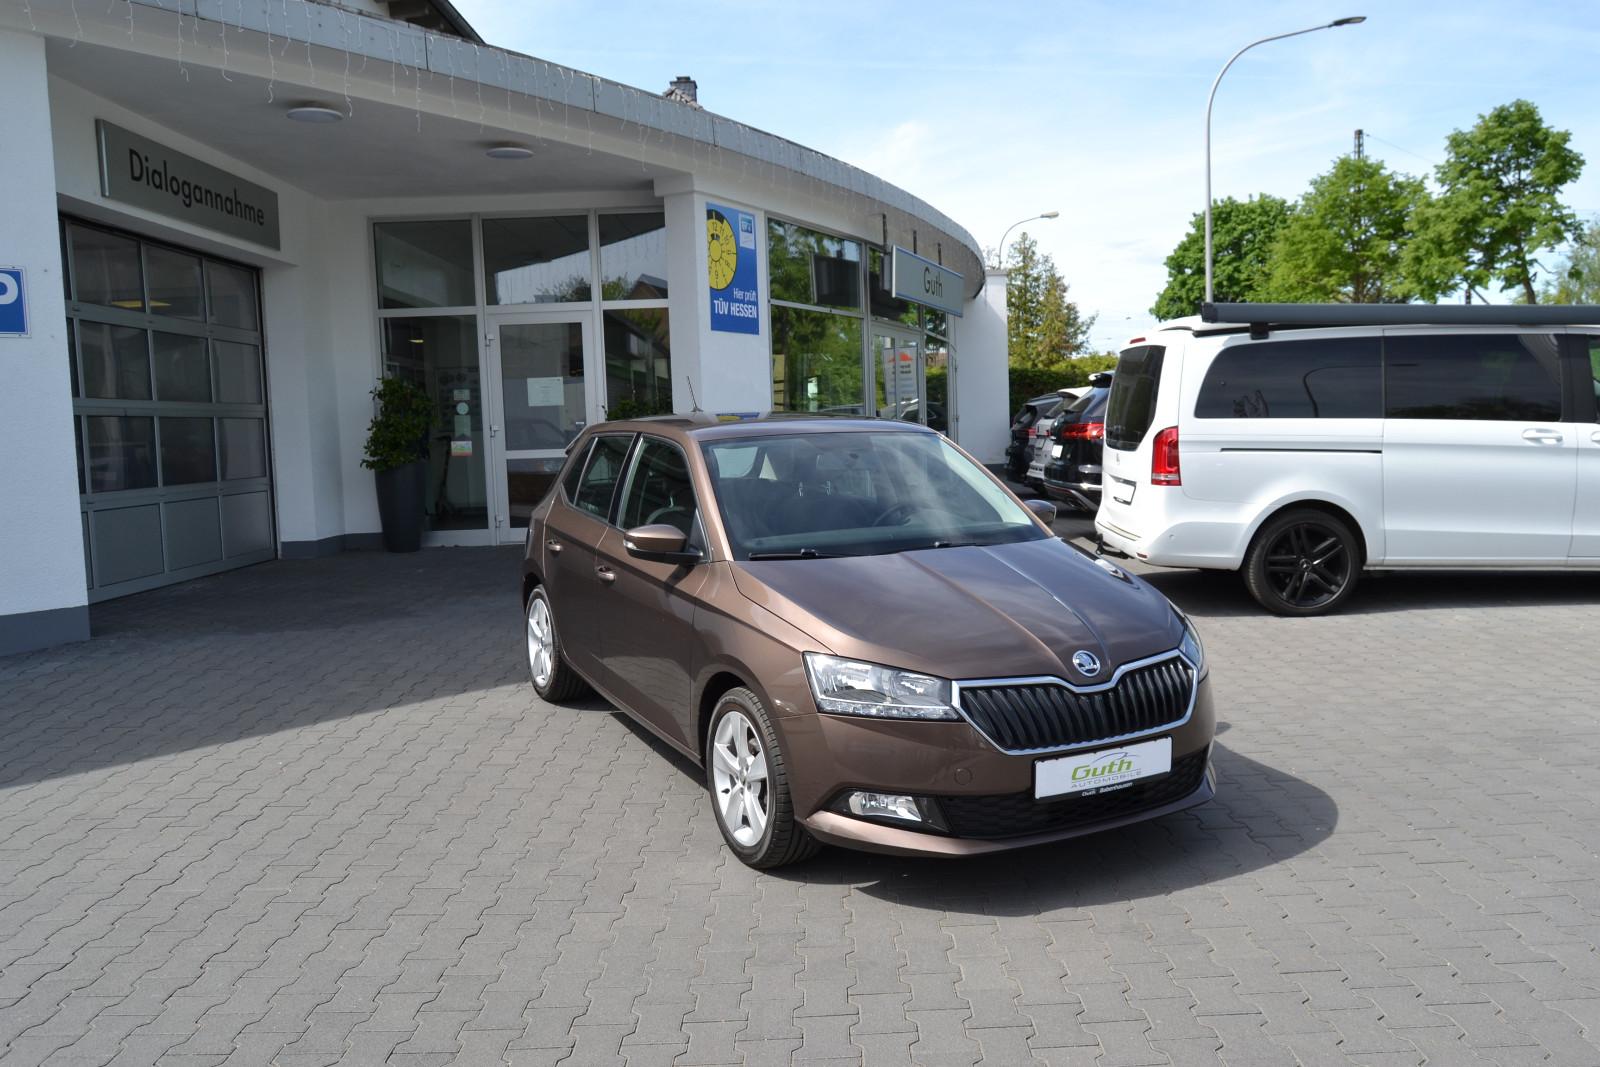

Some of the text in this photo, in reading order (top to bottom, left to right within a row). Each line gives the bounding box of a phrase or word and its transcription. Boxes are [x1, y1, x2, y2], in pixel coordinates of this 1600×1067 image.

[129, 148, 264, 226] Dialogannahme
[924, 266, 943, 297] Guth
[733, 287, 757, 302] Hier prüft
[713, 297, 757, 319] TÜV HESSEN
[1071, 770, 1142, 788] AUTOMOBILE
[1072, 759, 1132, 780] Guth
